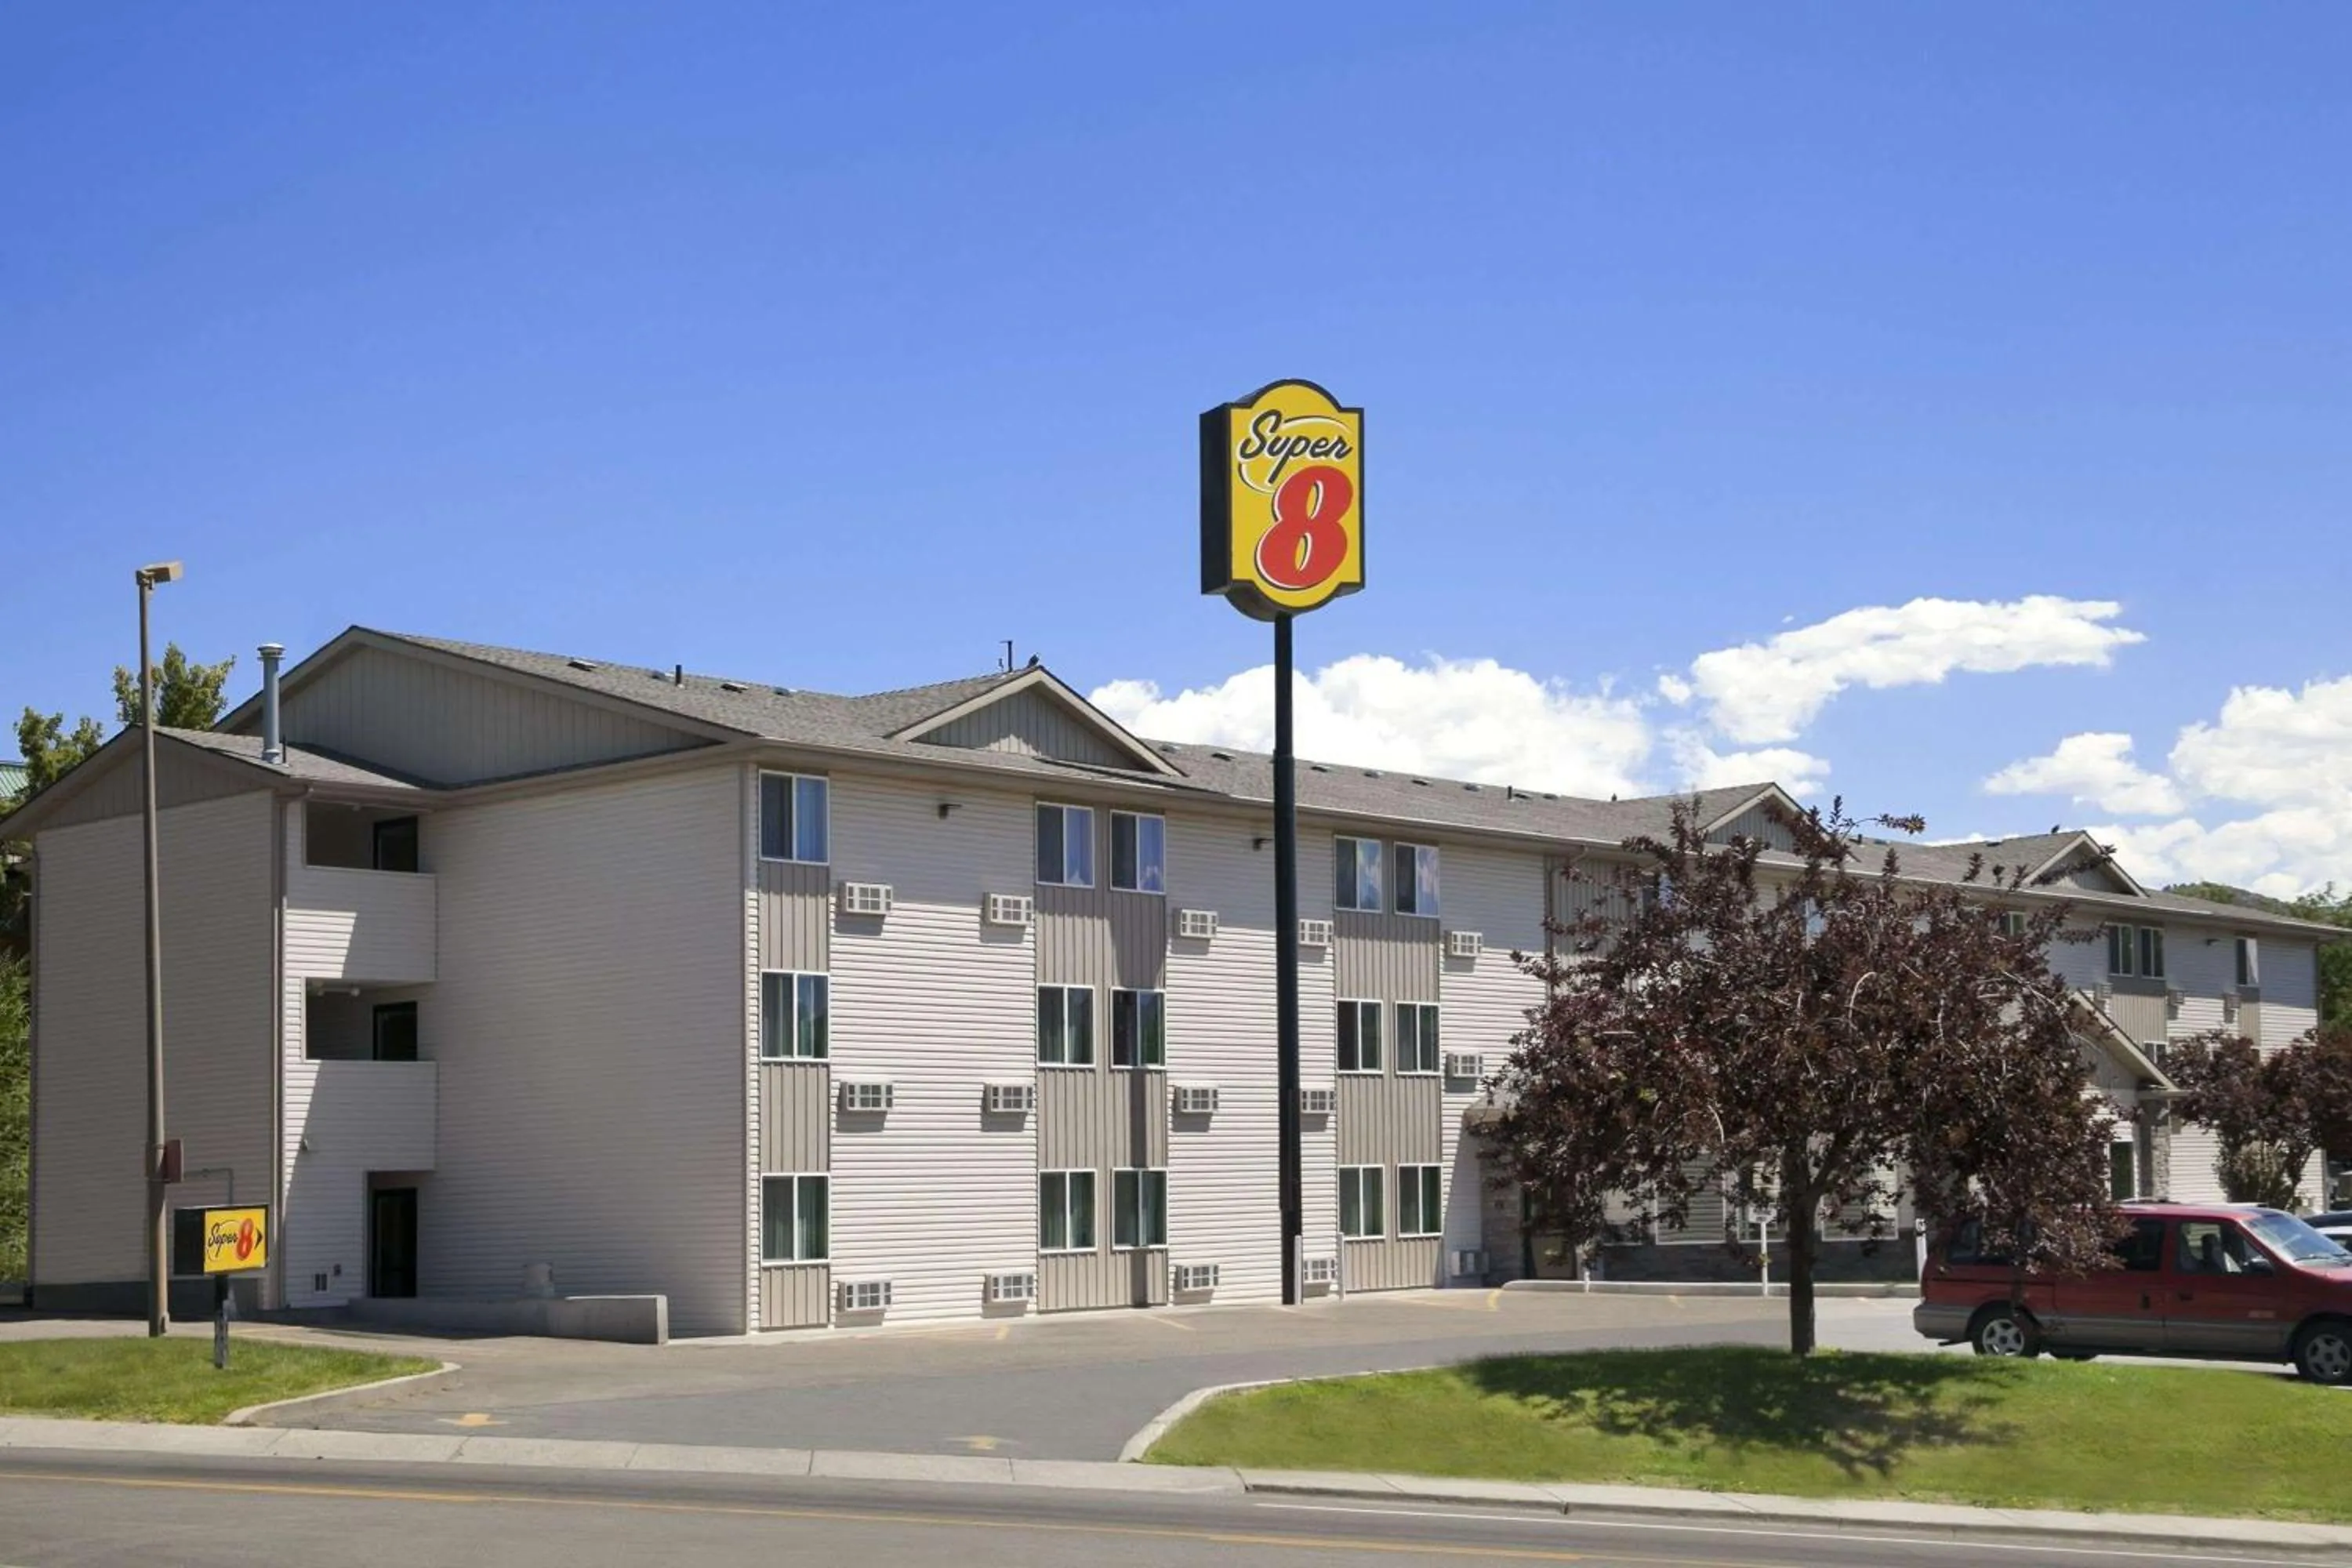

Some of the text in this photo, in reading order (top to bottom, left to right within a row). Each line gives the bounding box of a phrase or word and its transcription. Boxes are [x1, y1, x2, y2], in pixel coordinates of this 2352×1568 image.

[1238, 408, 1354, 485] Super
[1254, 464, 1354, 591] 8
[208, 1218, 254, 1261] Super 8
